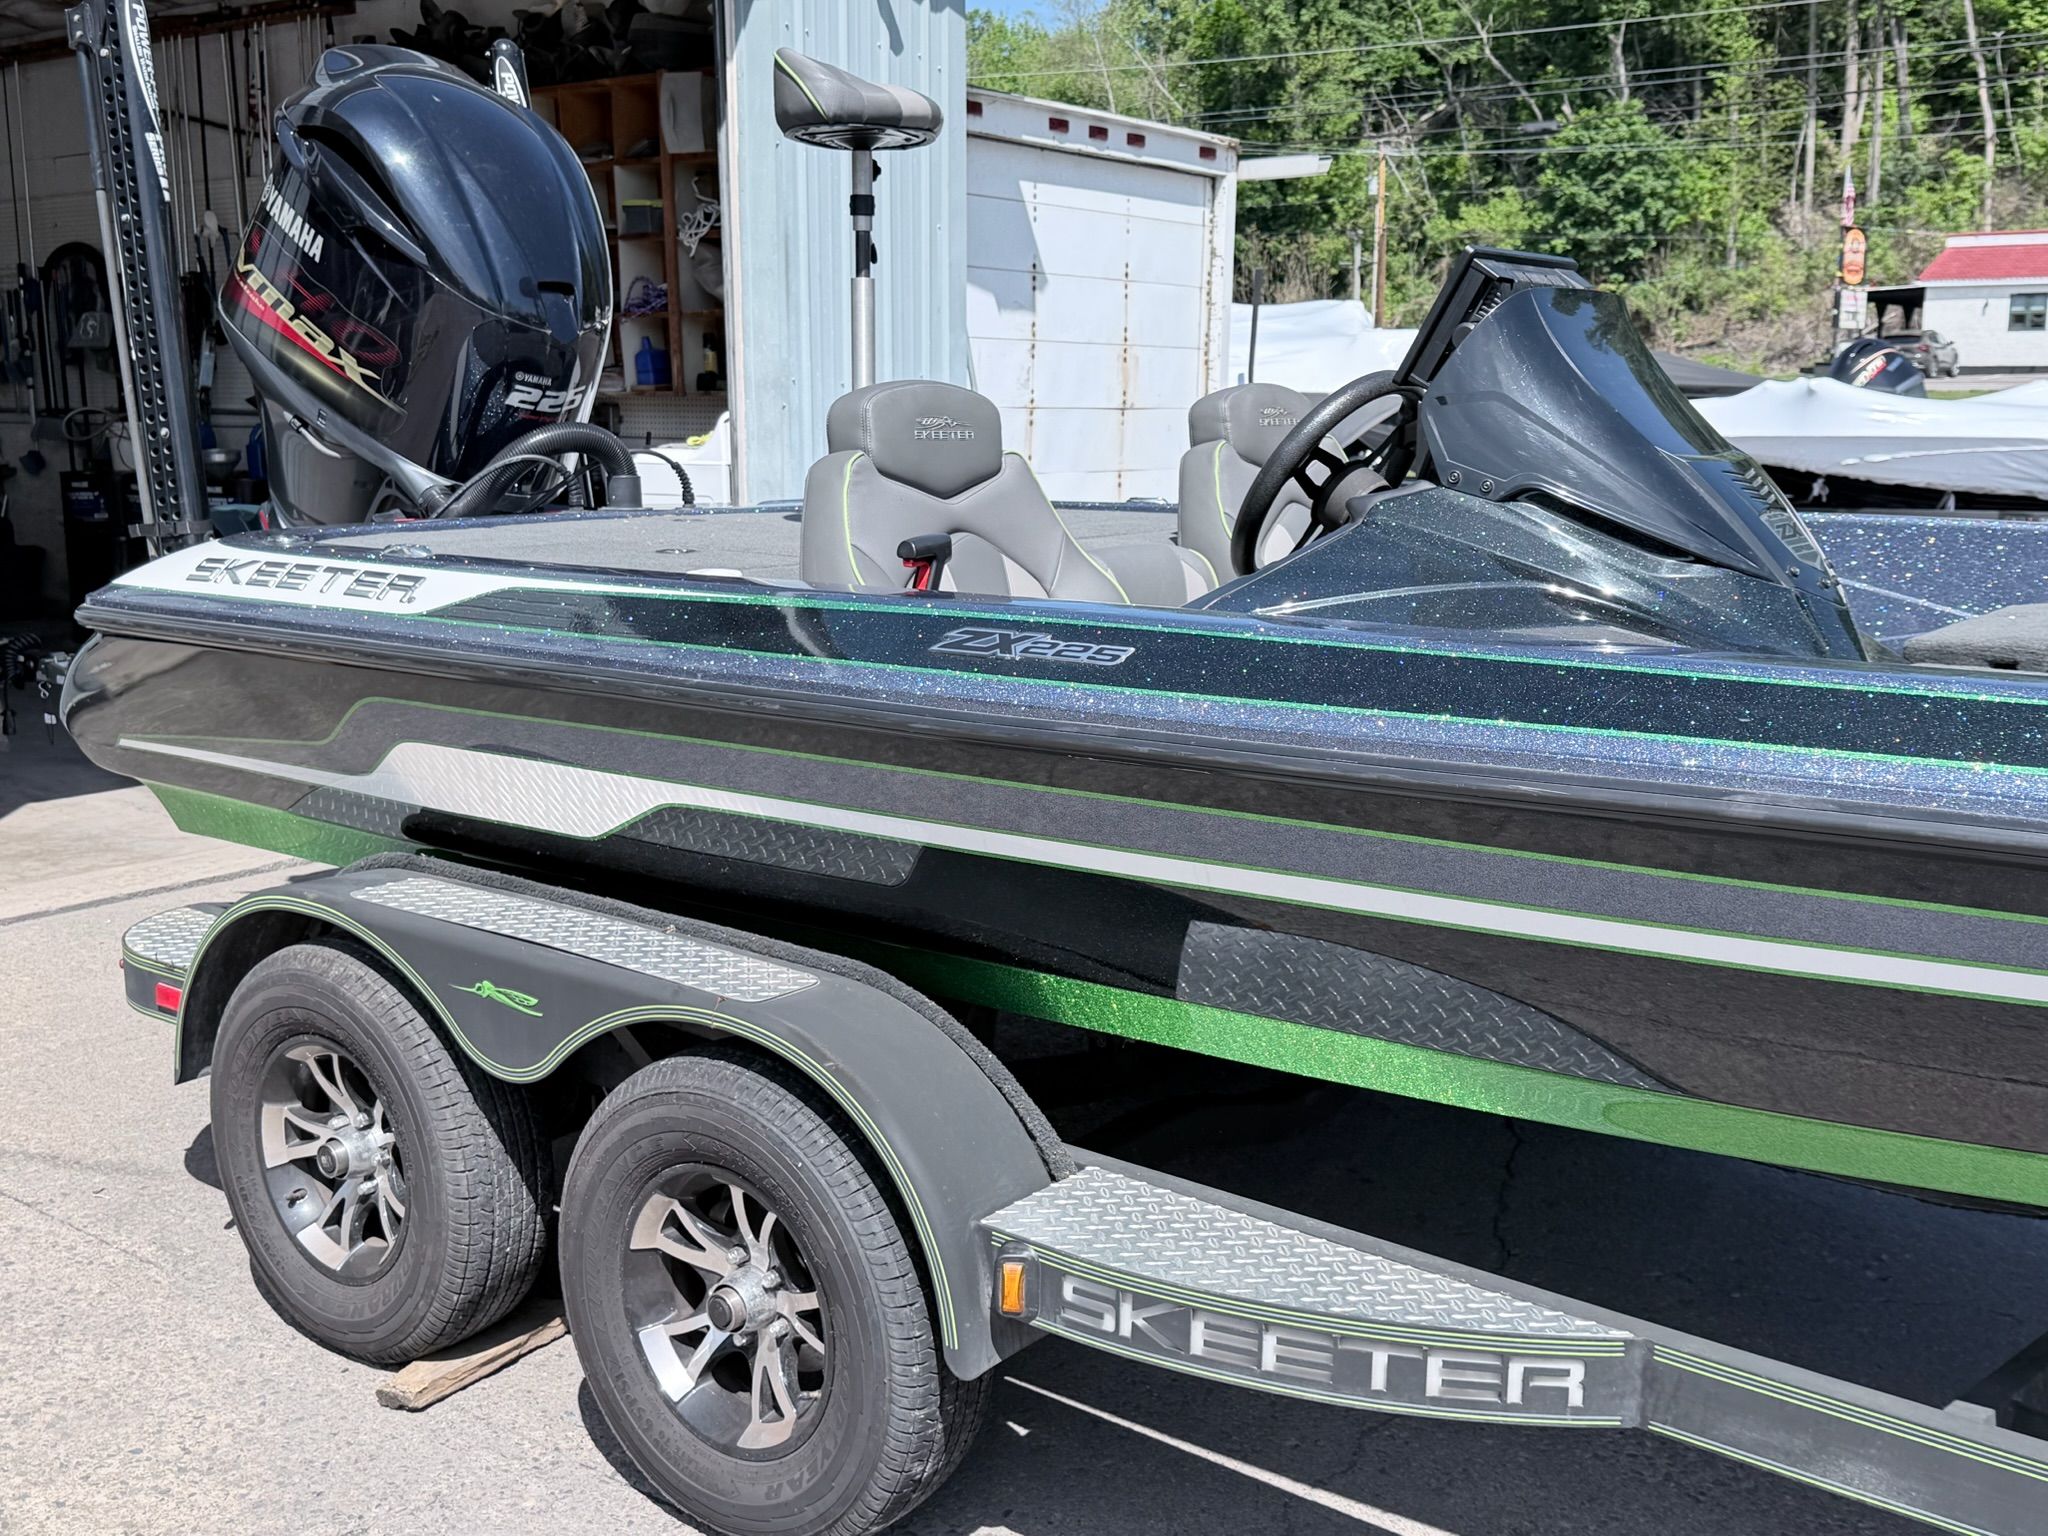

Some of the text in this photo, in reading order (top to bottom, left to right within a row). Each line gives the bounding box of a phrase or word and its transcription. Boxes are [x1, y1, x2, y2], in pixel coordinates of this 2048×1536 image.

[264, 185, 324, 264] YAMAHA
[524, 373, 552, 386] YAMAHA
[505, 384, 587, 413] 225
[914, 430, 975, 440] SKEETER
[186, 558, 427, 603] SKEETER
[1061, 1273, 1587, 1408] SKEETER
